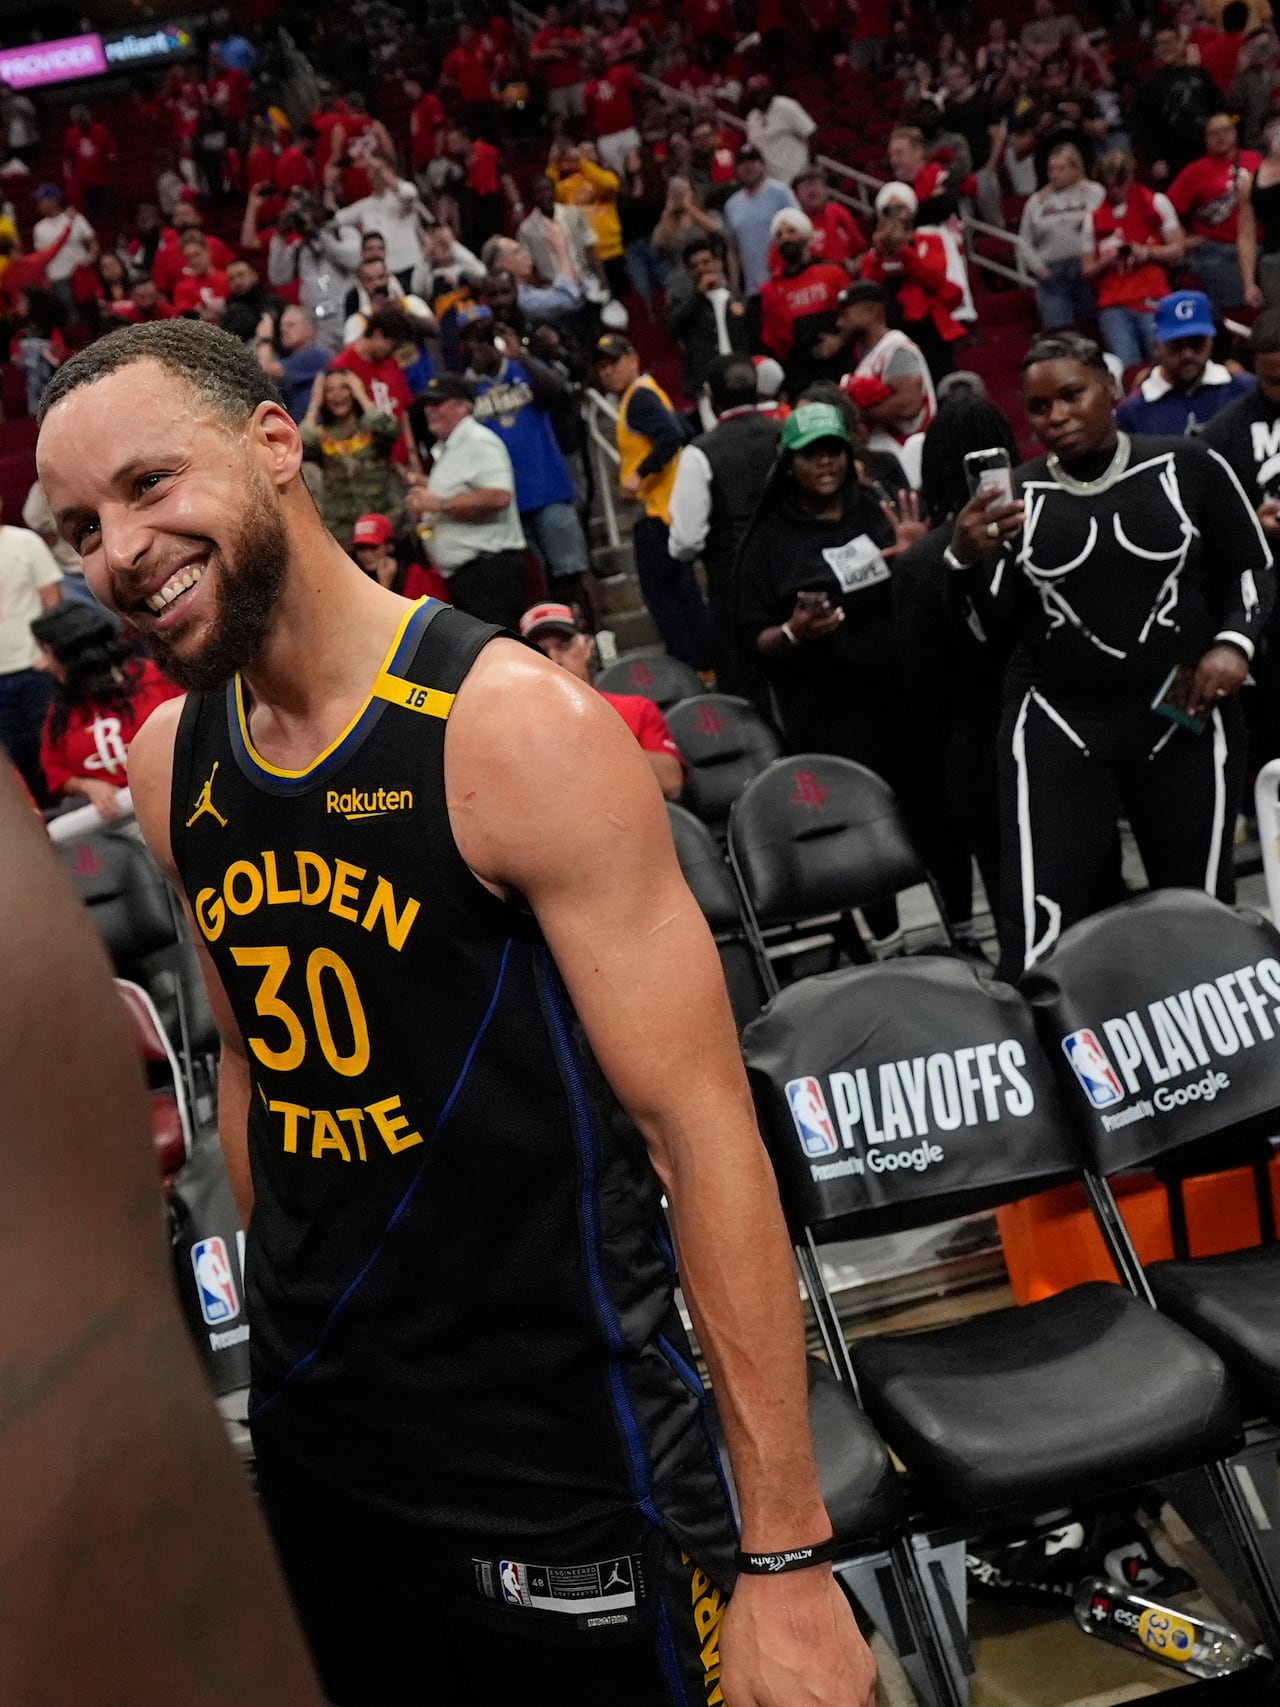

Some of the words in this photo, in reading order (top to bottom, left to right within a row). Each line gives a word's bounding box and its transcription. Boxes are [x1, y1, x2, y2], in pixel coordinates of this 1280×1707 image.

[405, 687, 428, 708] 16
[326, 787, 413, 814] Rakuten
[195, 850, 421, 952] GOLDEN
[229, 946, 370, 1077] 30
[829, 1039, 1035, 1149] PLAYOFFS
[1153, 1068, 1231, 1112] Google
[256, 1081, 424, 1162] TATE
[867, 1140, 944, 1172] Google
[784, 1549, 813, 1562] ACTIVE
[531, 1578, 545, 1588] 48
[1146, 1612, 1170, 1649] 32
